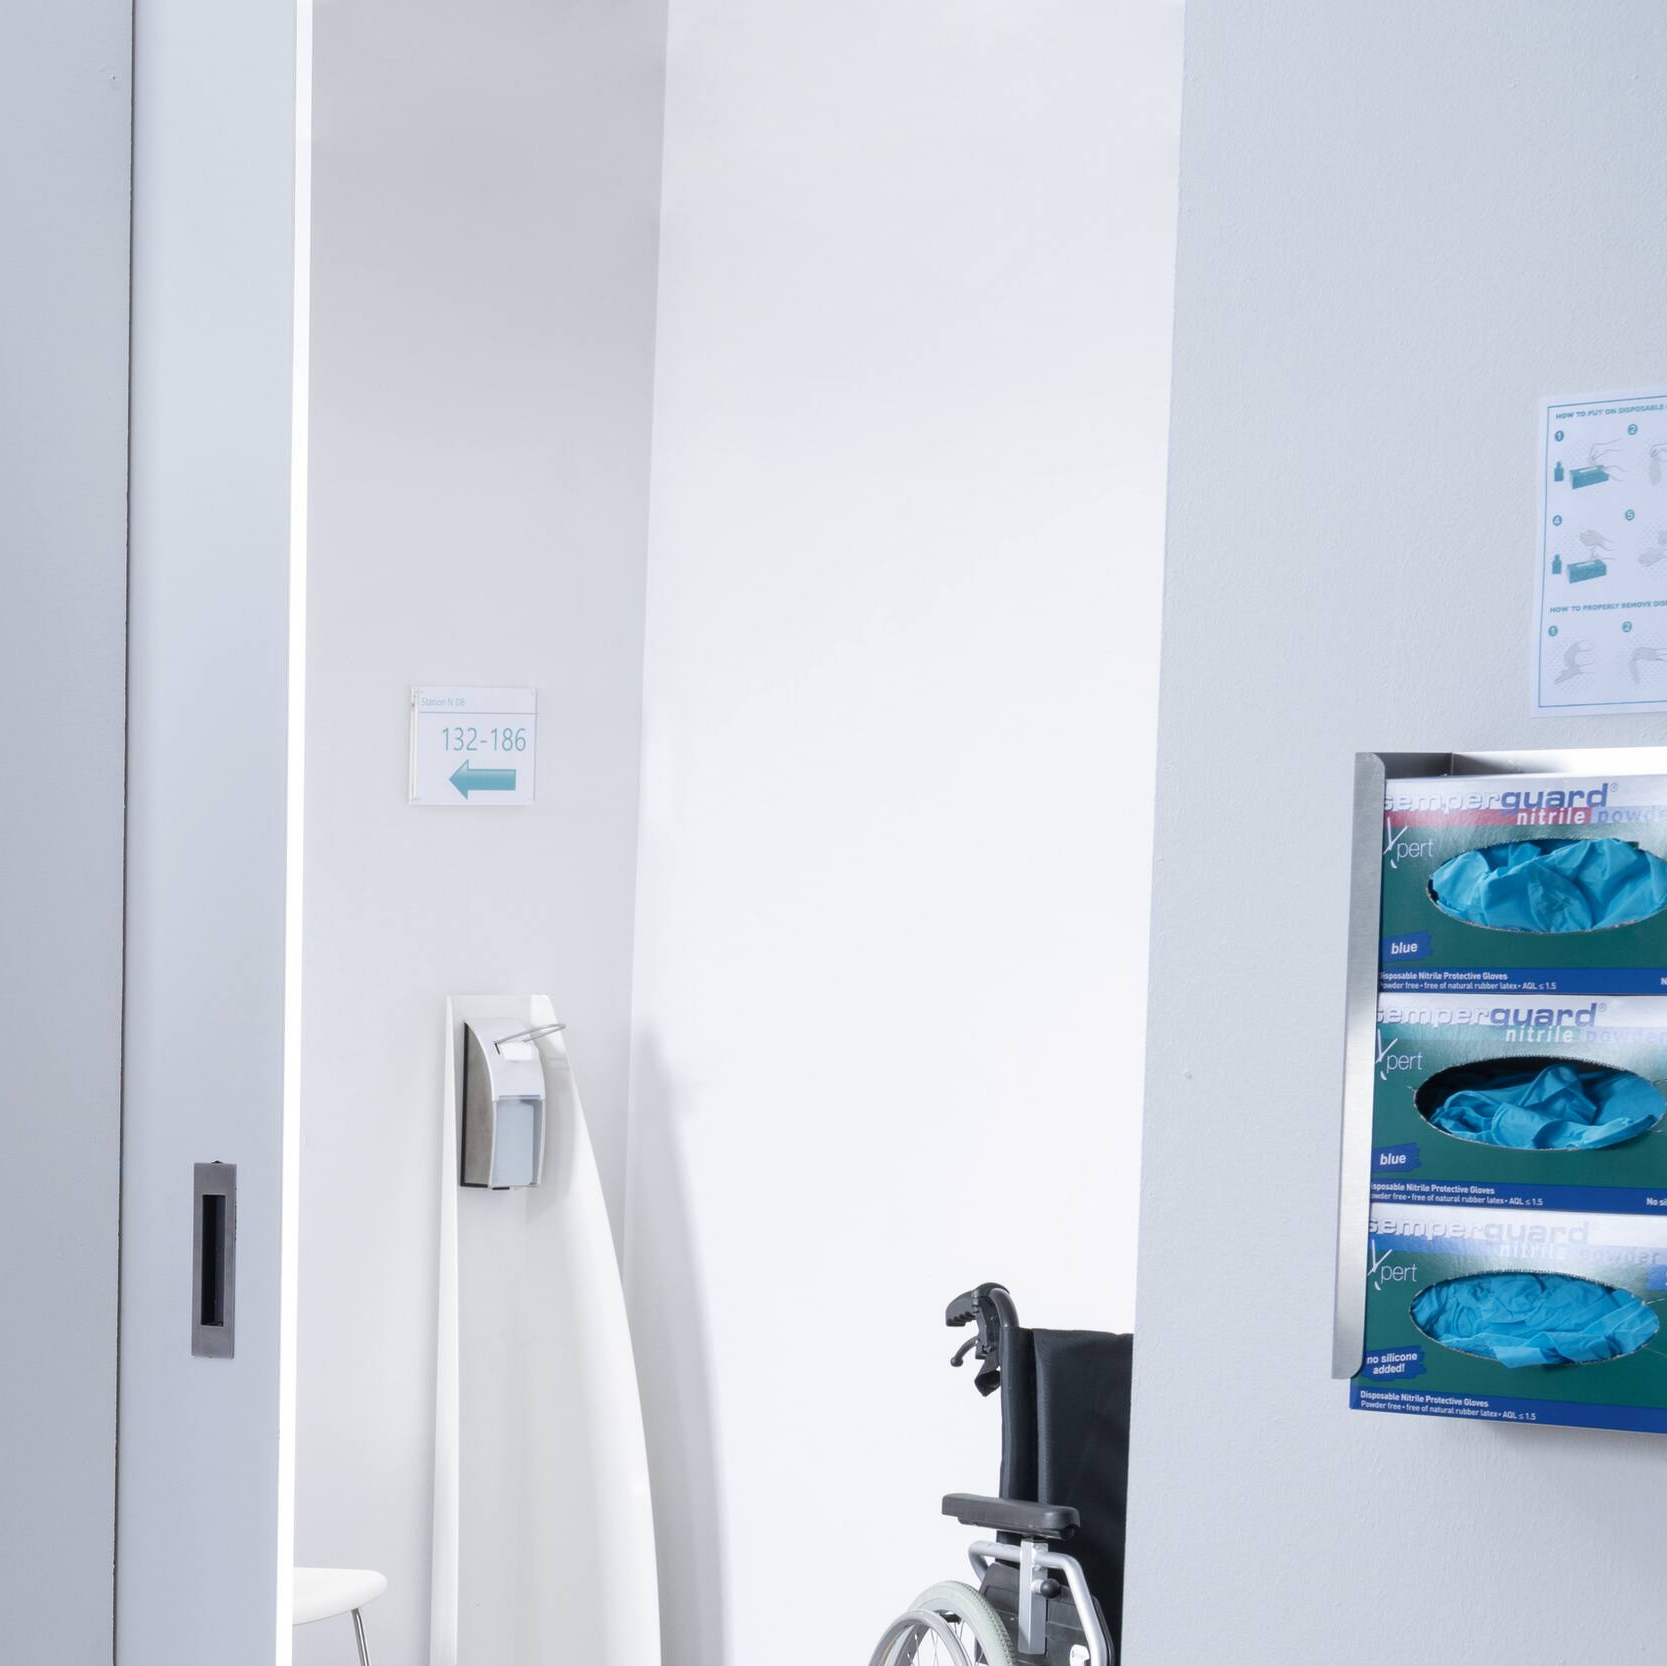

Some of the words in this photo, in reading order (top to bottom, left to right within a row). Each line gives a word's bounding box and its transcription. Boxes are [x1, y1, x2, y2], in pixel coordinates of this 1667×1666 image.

[422, 697, 446, 706] Station
[442, 727, 527, 752] 132-186
[1517, 808, 1585, 826] nitrile
[1391, 942, 1418, 955] blue
[1419, 971, 1442, 980] Nitrile
[1443, 971, 1481, 981] Protective
[1482, 972, 1508, 981] Gloves
[1383, 981, 1405, 990] owder
[1405, 981, 1419, 990] free
[1424, 981, 1438, 990] free
[1439, 981, 1447, 990] of
[1447, 982, 1473, 990] natural
[1474, 982, 1498, 990] rubber
[1500, 982, 1517, 990] latex
[1522, 982, 1537, 990] AQL
[1506, 1025, 1573, 1043] nitrile
[1379, 1153, 1406, 1165] blue
[1406, 1183, 1430, 1192] Nitrile
[1431, 1184, 1469, 1194] Protective
[1470, 1186, 1495, 1195] Gloves
[1393, 1192, 1407, 1200] free
[1412, 1193, 1426, 1201] free
[1435, 1194, 1460, 1203] natural
[1462, 1195, 1485, 1204] rubber
[1486, 1196, 1504, 1204] latex
[1509, 1198, 1524, 1206] AQL
[1367, 1355, 1379, 1364] no
[1381, 1352, 1418, 1363] silicone
[1373, 1363, 1405, 1375] added!
[1360, 1390, 1400, 1402] Disposable
[1401, 1393, 1425, 1403] Nitrile
[1425, 1395, 1463, 1406] Protective
[1464, 1398, 1489, 1407] Gloves
[1361, 1400, 1385, 1409] Powder
[1387, 1401, 1401, 1410] free
[1406, 1403, 1420, 1412] free
[1421, 1404, 1429, 1412] of
[1429, 1405, 1454, 1415] natural
[1455, 1407, 1479, 1417] rubber
[1480, 1409, 1497, 1417] latex
[1502, 1411, 1517, 1419] AQL
